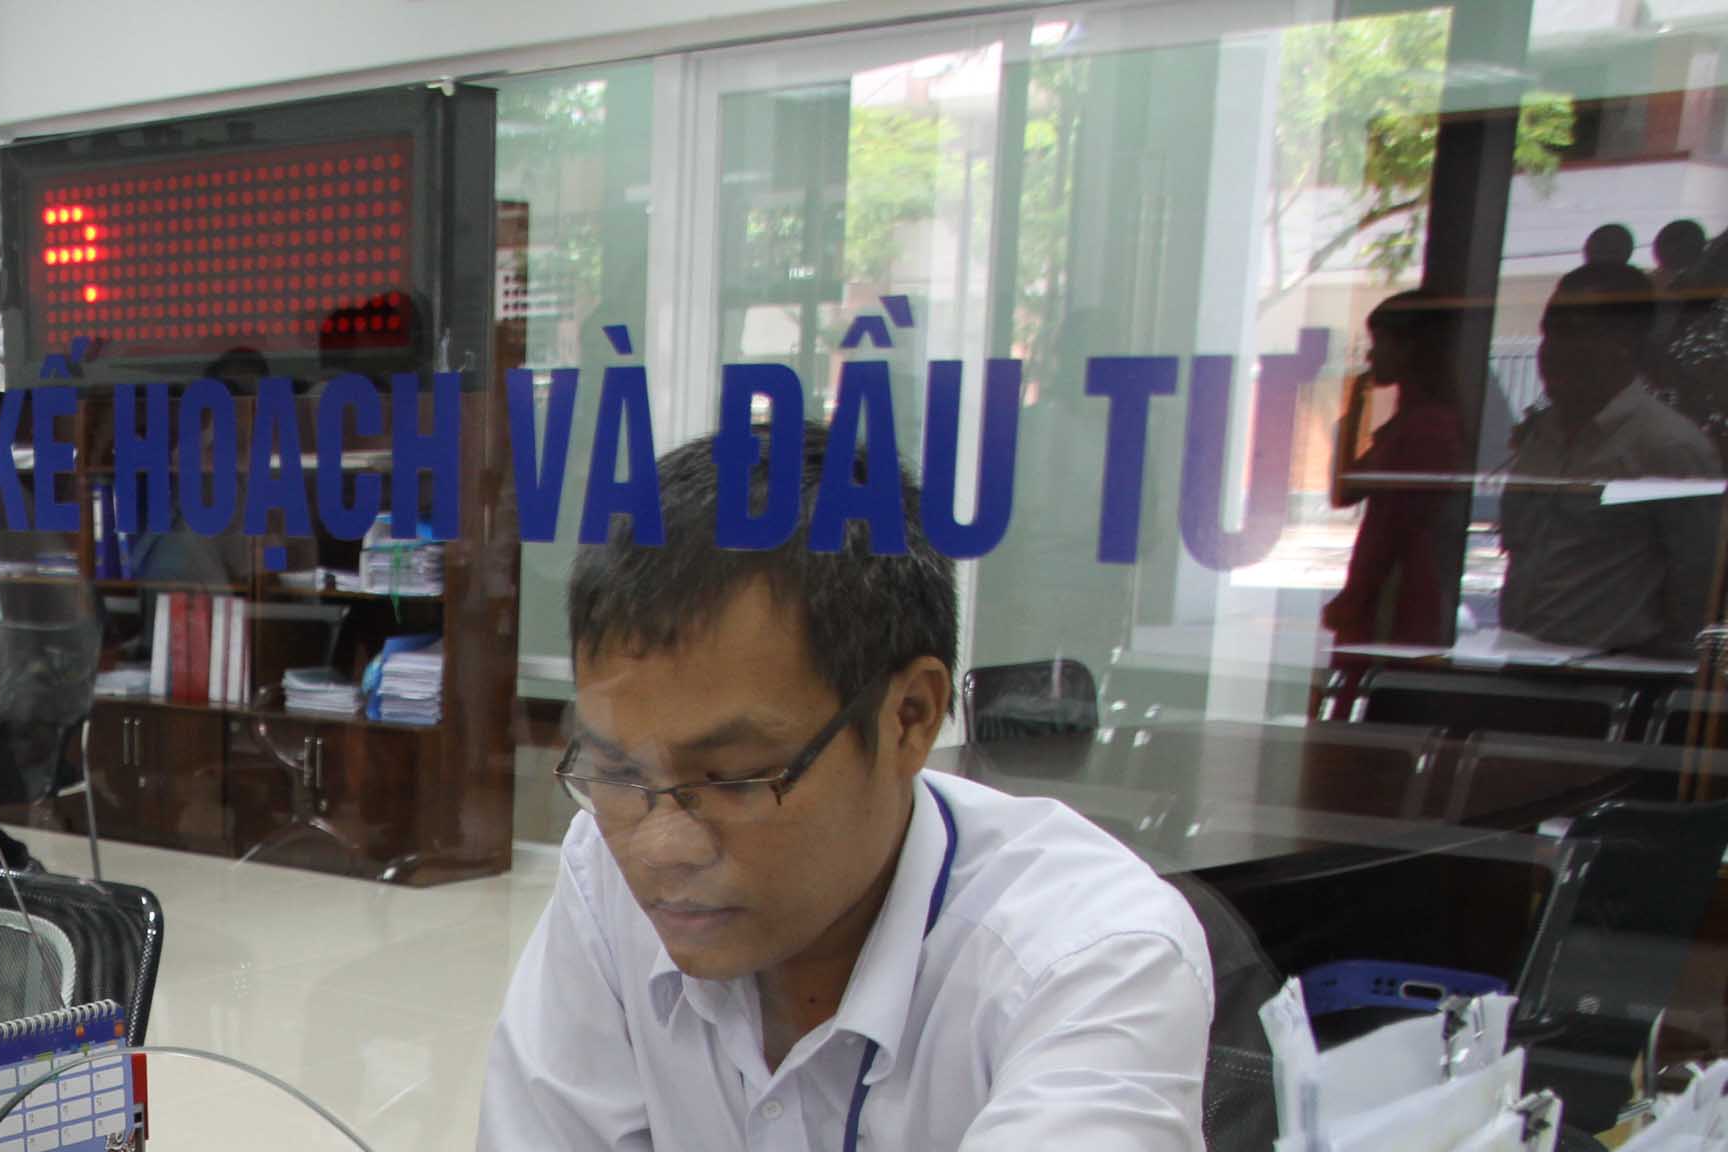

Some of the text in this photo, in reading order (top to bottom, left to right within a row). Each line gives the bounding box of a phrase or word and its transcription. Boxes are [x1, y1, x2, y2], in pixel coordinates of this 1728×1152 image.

[114, 371, 461, 570] HOẠCH
[505, 324, 666, 546] VÀ
[711, 295, 1023, 560] ĐẦU
[1084, 326, 1330, 572] TƯ
